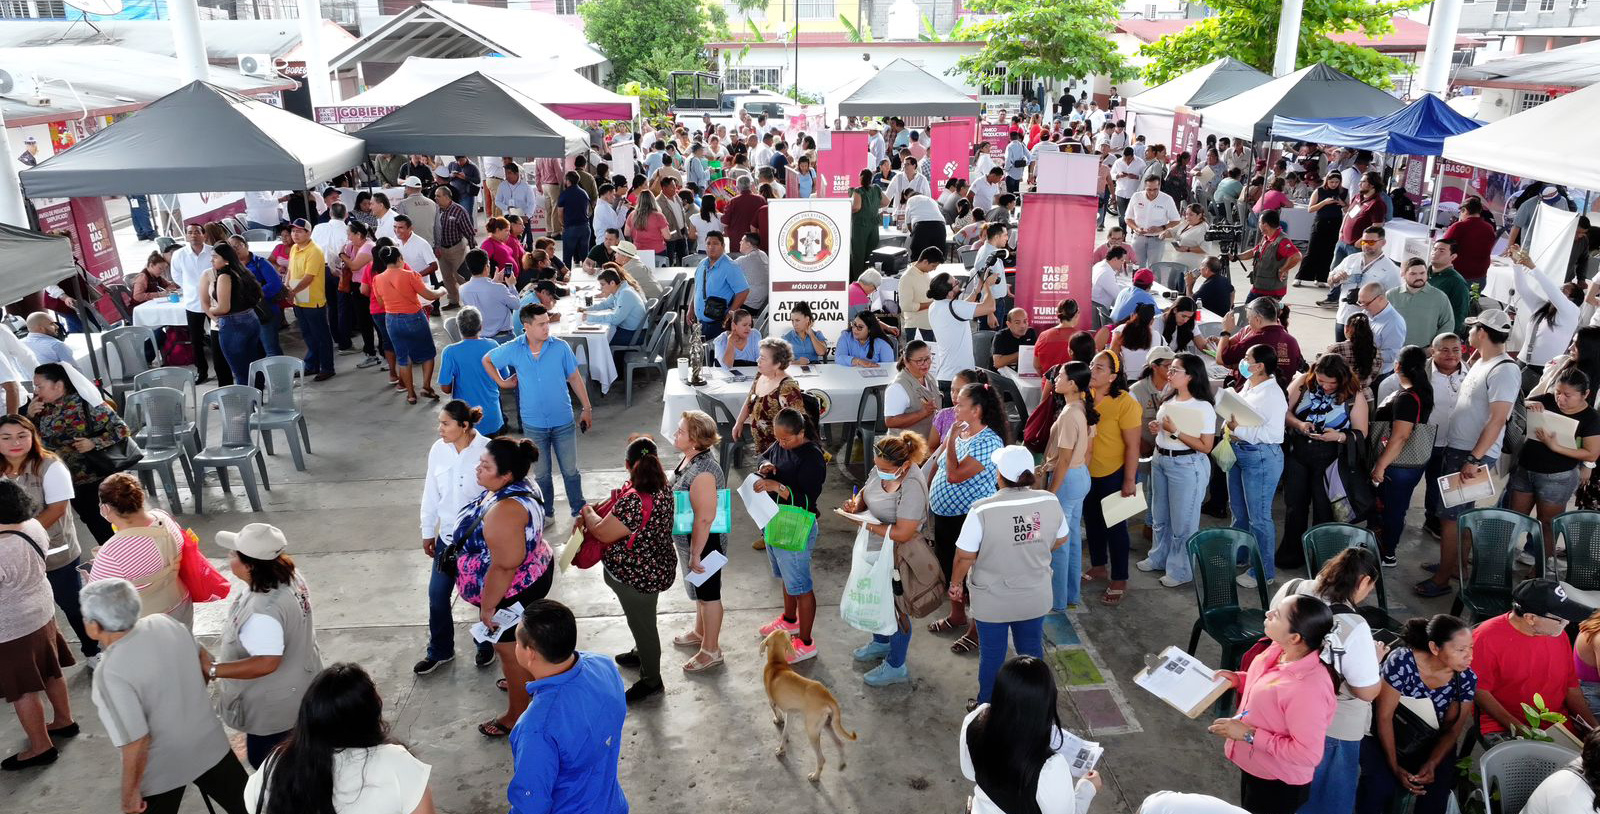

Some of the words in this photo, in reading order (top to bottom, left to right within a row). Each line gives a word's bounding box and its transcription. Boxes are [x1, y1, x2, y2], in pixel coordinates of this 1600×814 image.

[285, 66, 308, 75] BODEG
[1436, 162, 1472, 174] TBASCO
[87, 222, 97, 233] TA
[90, 231, 103, 243] BAS
[93, 241, 102, 252] CO
[99, 266, 119, 281] SALUD
[1043, 265, 1053, 274] TA
[1042, 274, 1060, 282] BAS
[1042, 282, 1054, 290] CO
[778, 299, 839, 311] ATCIÓN
[773, 312, 845, 322] CIUDANA
[1012, 515, 1025, 525] TA
[1014, 523, 1032, 533] BAS
[1014, 533, 1026, 542] CO
